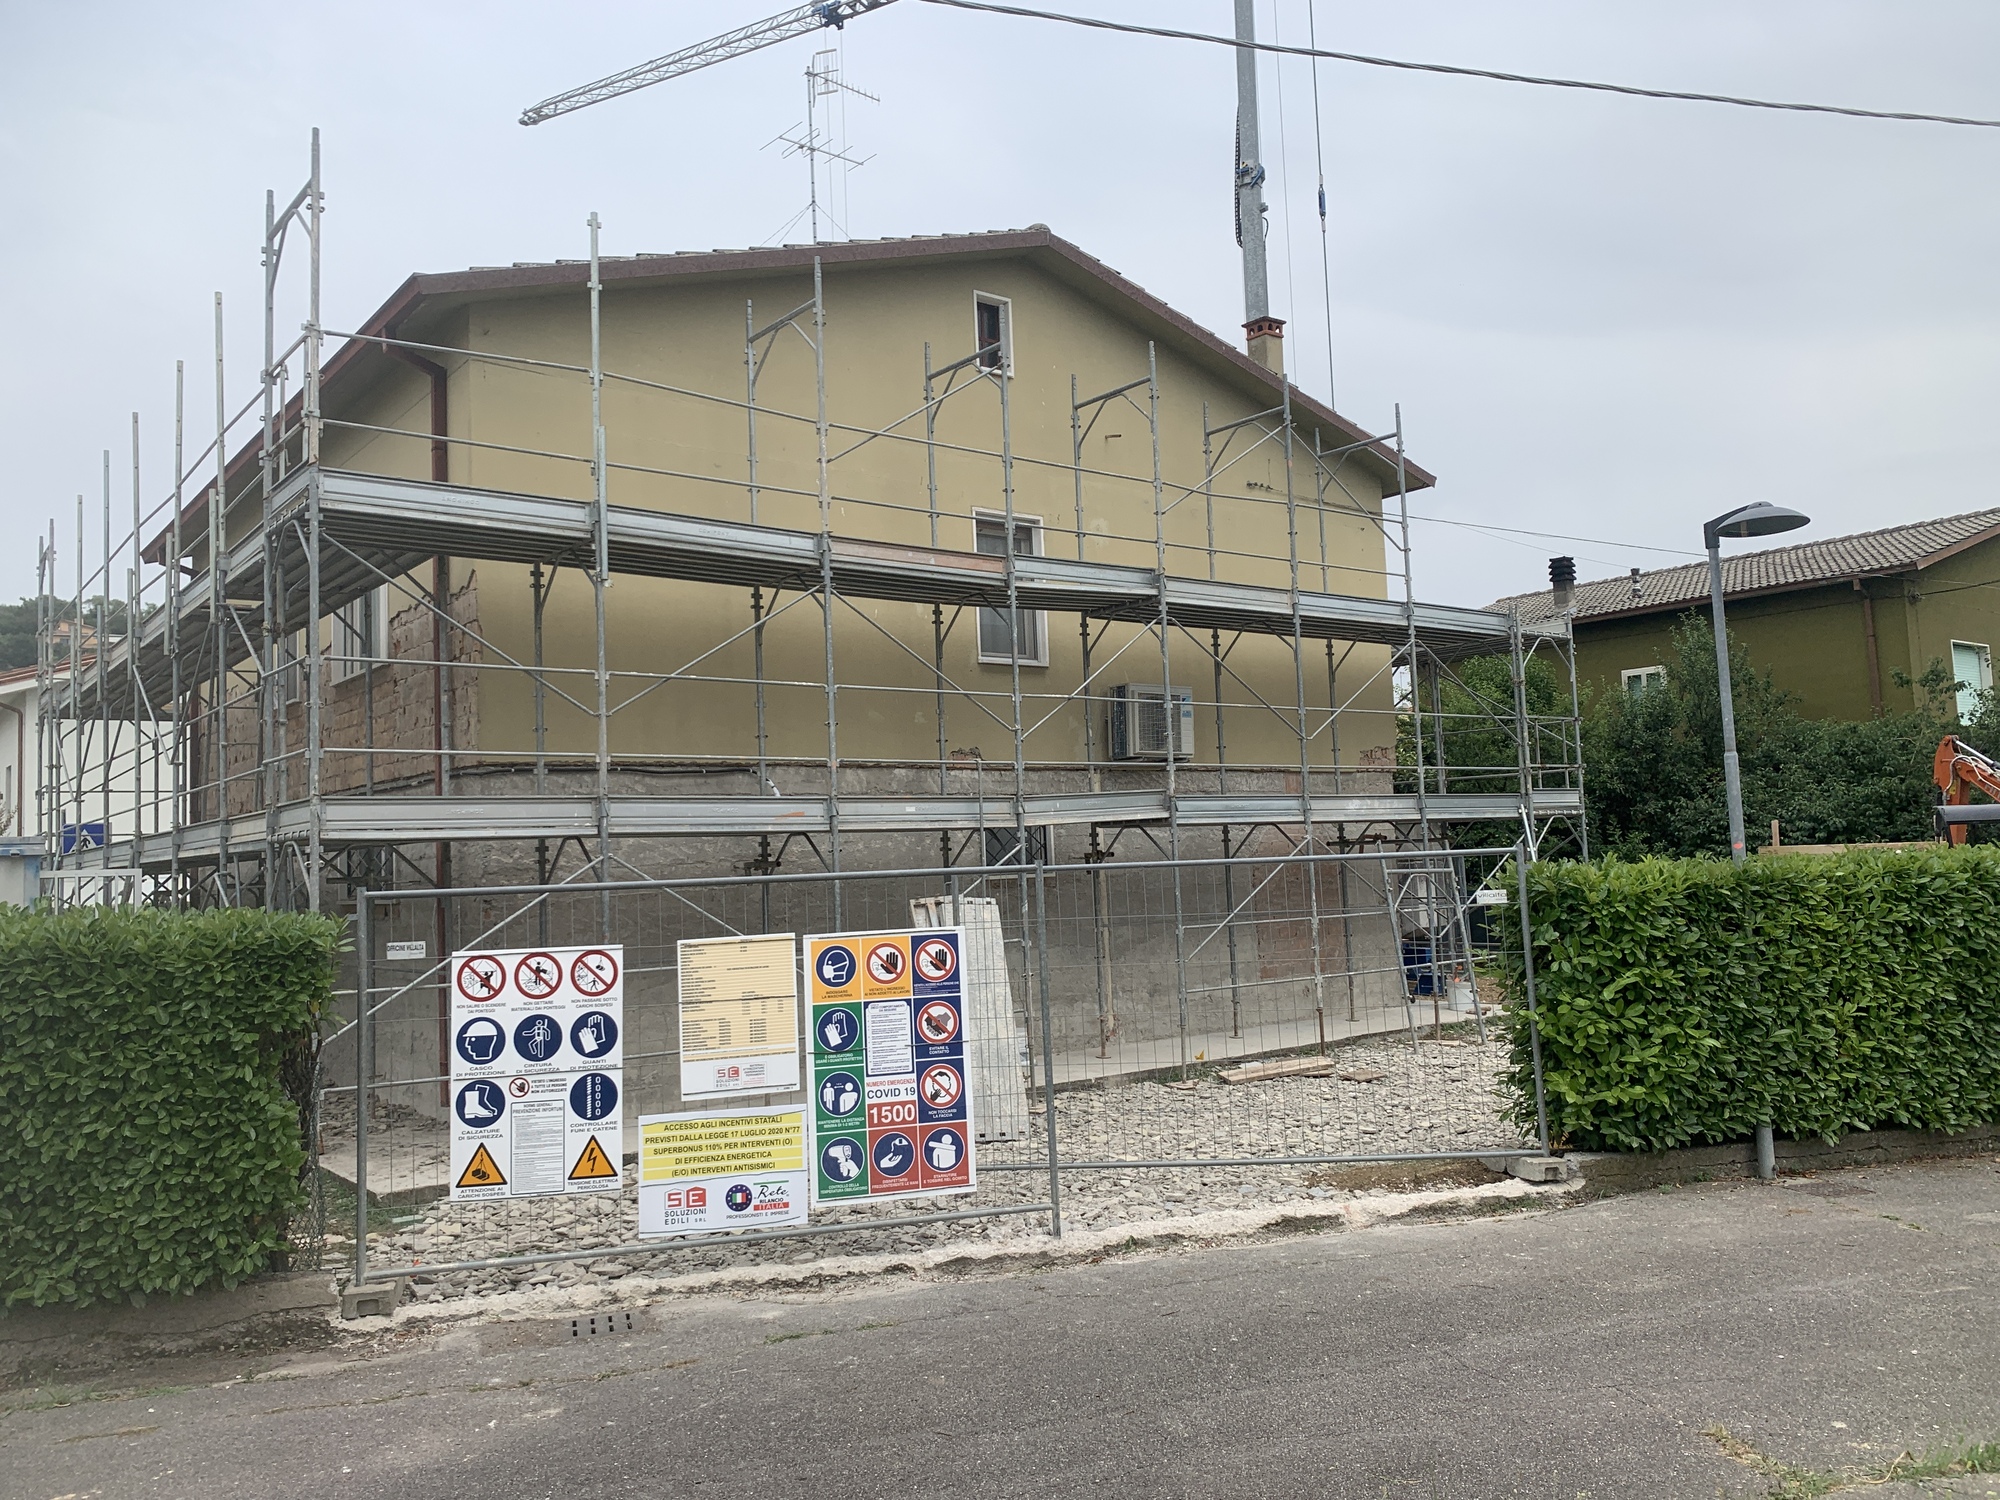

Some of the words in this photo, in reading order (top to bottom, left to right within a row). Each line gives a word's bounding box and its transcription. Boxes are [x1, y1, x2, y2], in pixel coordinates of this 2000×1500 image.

[867, 1088, 901, 1099] COVID
[905, 1086, 916, 1096] 19
[869, 1104, 915, 1124] 1500
[664, 1123, 699, 1131] ACCESSO
[719, 1119, 753, 1127] INCENTIVI
[754, 1116, 782, 1125] STATALI
[645, 1136, 678, 1144] PREVISTI
[680, 1133, 703, 1141] DALLA
[740, 1129, 766, 1137] LUGLIO
[654, 1145, 703, 1155] SUPERBONUS
[740, 1140, 780, 1148] INTERVENTI
[782, 1138, 792, 1146] (O)
[684, 1155, 725, 1164] EFFICIENZA
[727, 1151, 772, 1160] ENERGETICA
[672, 1168, 689, 1177] (E/O)
[690, 1166, 732, 1175] INTERVENTI
[733, 1162, 775, 1171] ANTISISMICI
[757, 1185, 788, 1199] Rete
[664, 1208, 706, 1218] SOLUZIONI
[664, 1217, 689, 1225] EDILI
